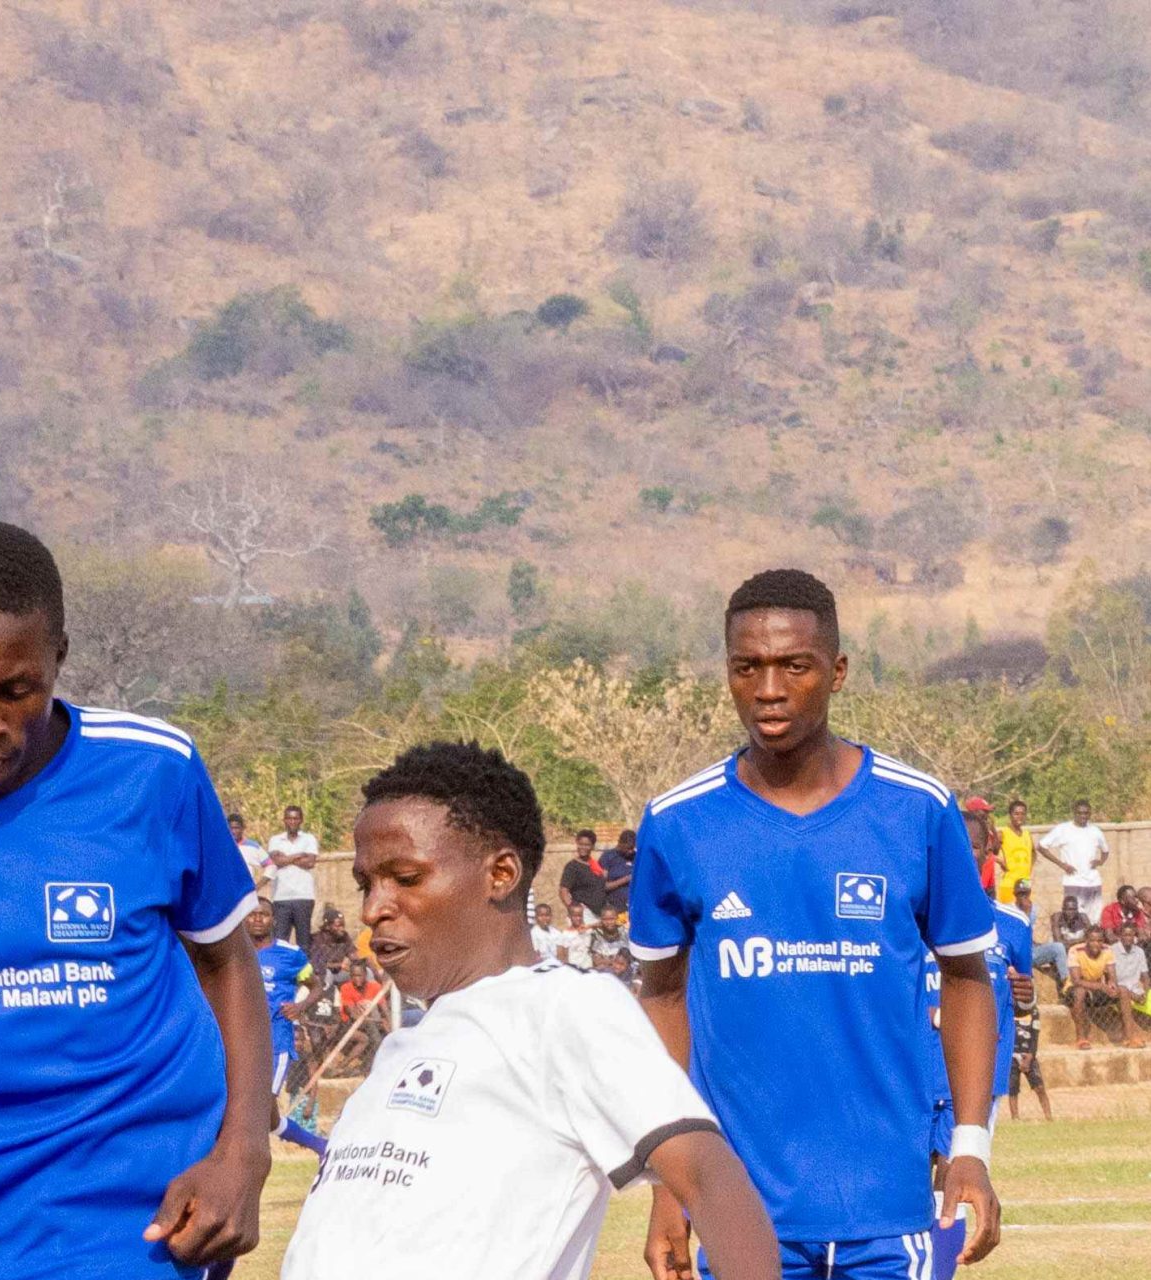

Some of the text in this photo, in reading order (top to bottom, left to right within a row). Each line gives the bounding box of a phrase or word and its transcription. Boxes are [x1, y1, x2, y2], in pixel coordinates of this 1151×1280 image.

[712, 908, 752, 921] adidas
[718, 937, 774, 979] NB
[776, 941, 881, 957] National Bank
[65, 961, 116, 983] Bank
[776, 957, 875, 976] of Malawi plc
[2, 985, 74, 1008] Malawi
[78, 984, 108, 1008] plc
[380, 1141, 431, 1169] Bank
[382, 1168, 414, 1188] plc
